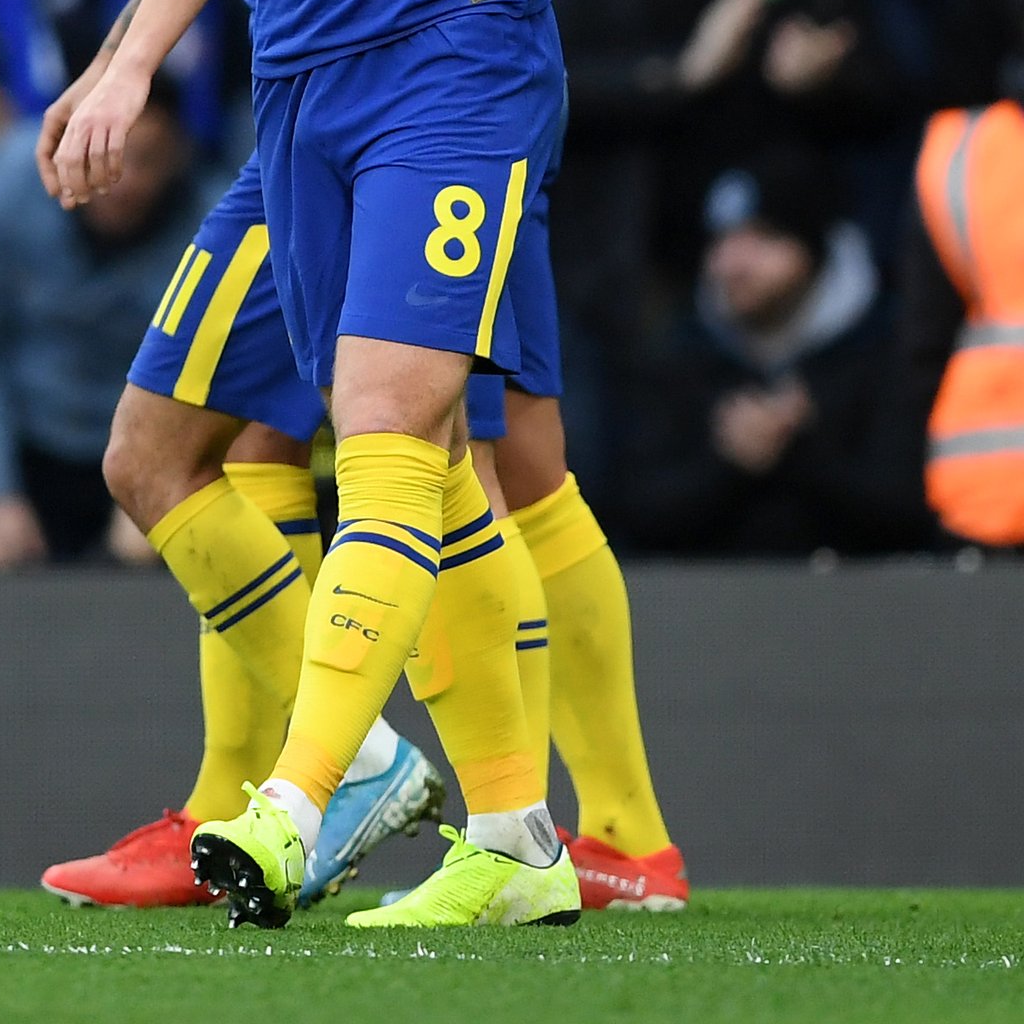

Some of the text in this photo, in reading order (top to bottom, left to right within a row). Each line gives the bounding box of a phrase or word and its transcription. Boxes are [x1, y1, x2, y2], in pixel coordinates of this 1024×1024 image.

[424, 184, 486, 277] 8
[151, 243, 213, 337] 11
[330, 613, 380, 642] CFC
